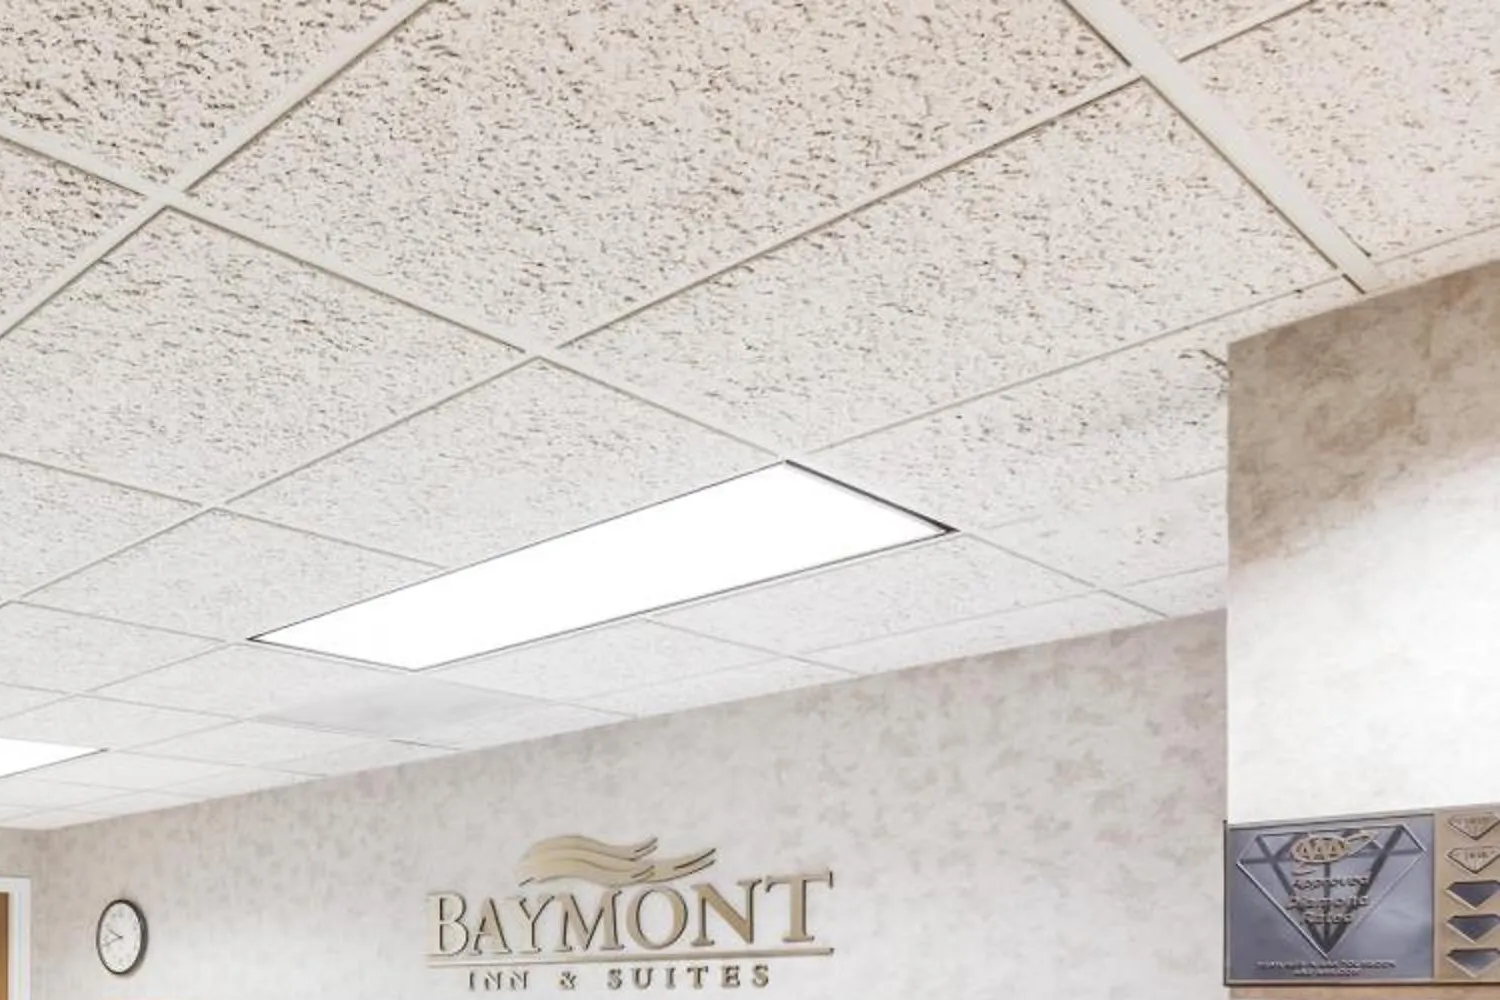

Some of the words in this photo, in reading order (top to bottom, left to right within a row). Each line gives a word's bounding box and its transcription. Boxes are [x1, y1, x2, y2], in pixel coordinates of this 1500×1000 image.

[426, 870, 834, 957] BAYMONT
[468, 970, 530, 991] INN
[559, 970, 578, 990] &
[606, 964, 772, 991] SUITES
